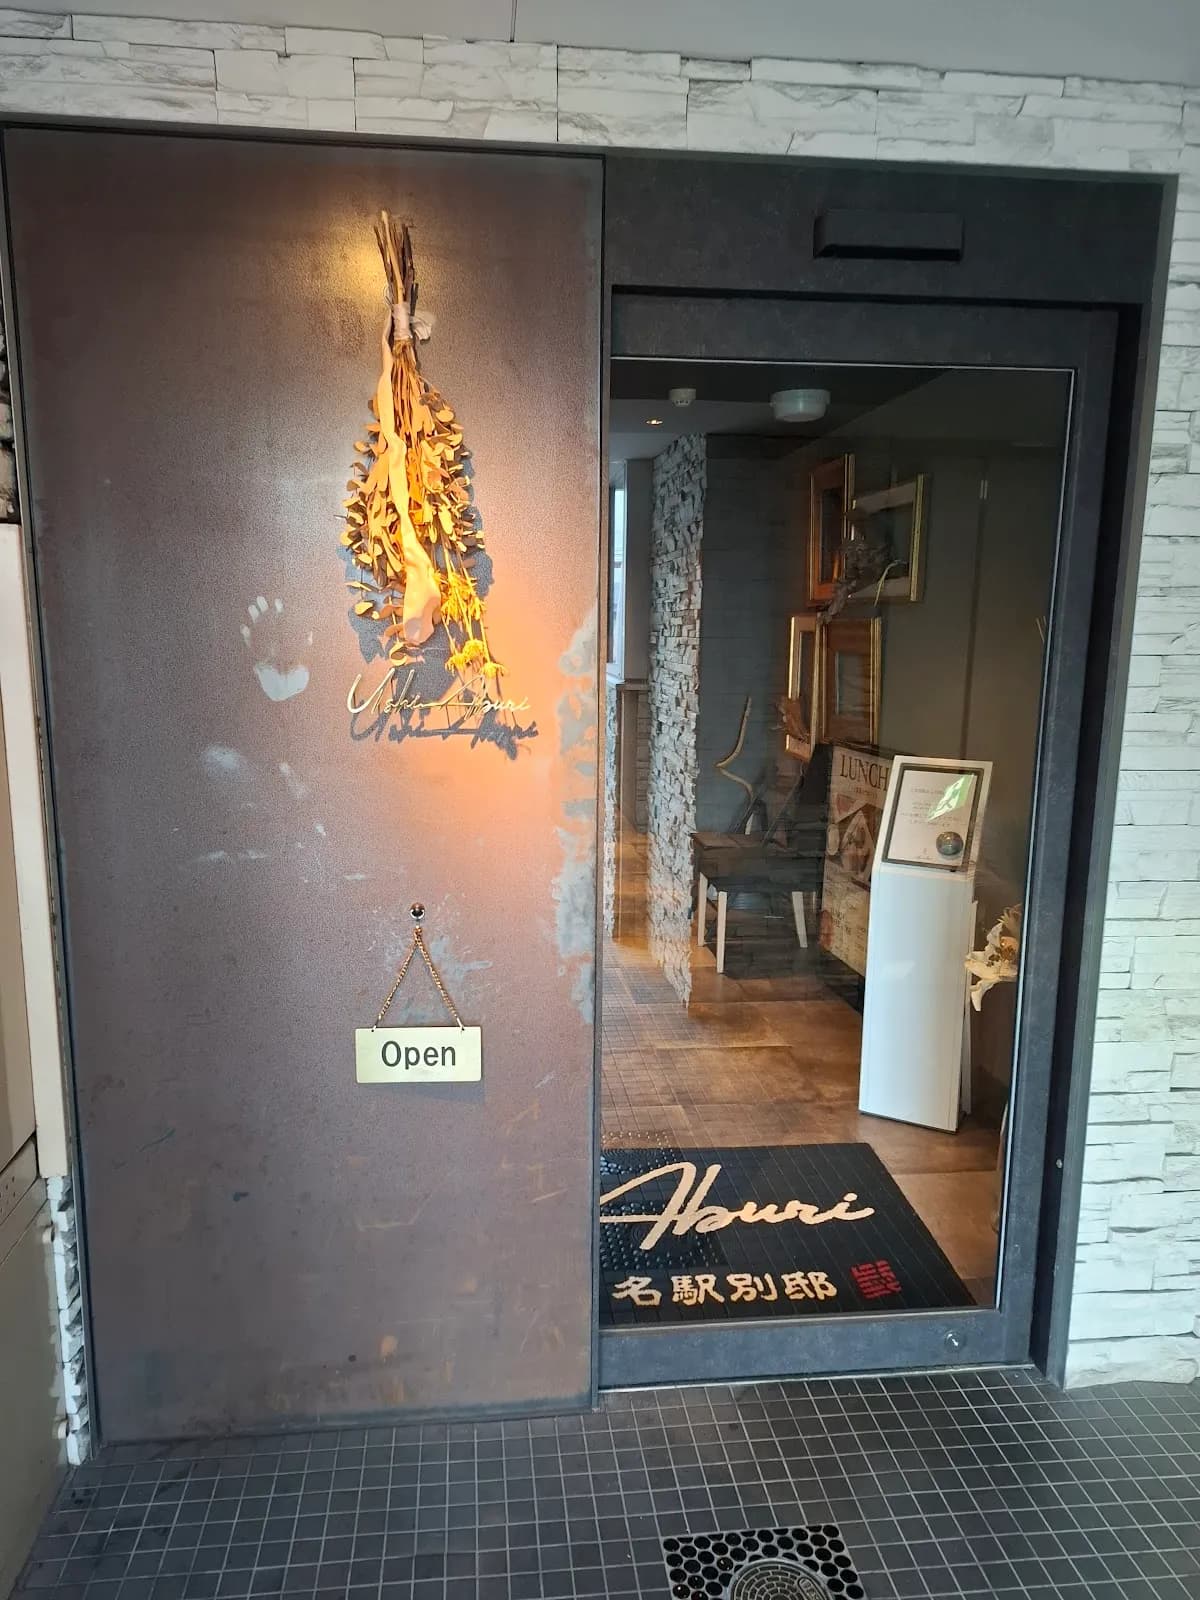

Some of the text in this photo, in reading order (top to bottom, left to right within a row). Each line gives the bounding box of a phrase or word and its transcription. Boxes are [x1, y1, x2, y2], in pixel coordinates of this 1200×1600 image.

[840, 754, 890, 792] LUNCH
[381, 1040, 456, 1070] Open
[600, 1161, 875, 1250] Aburi
[612, 1271, 838, 1307] 名駅別邸
